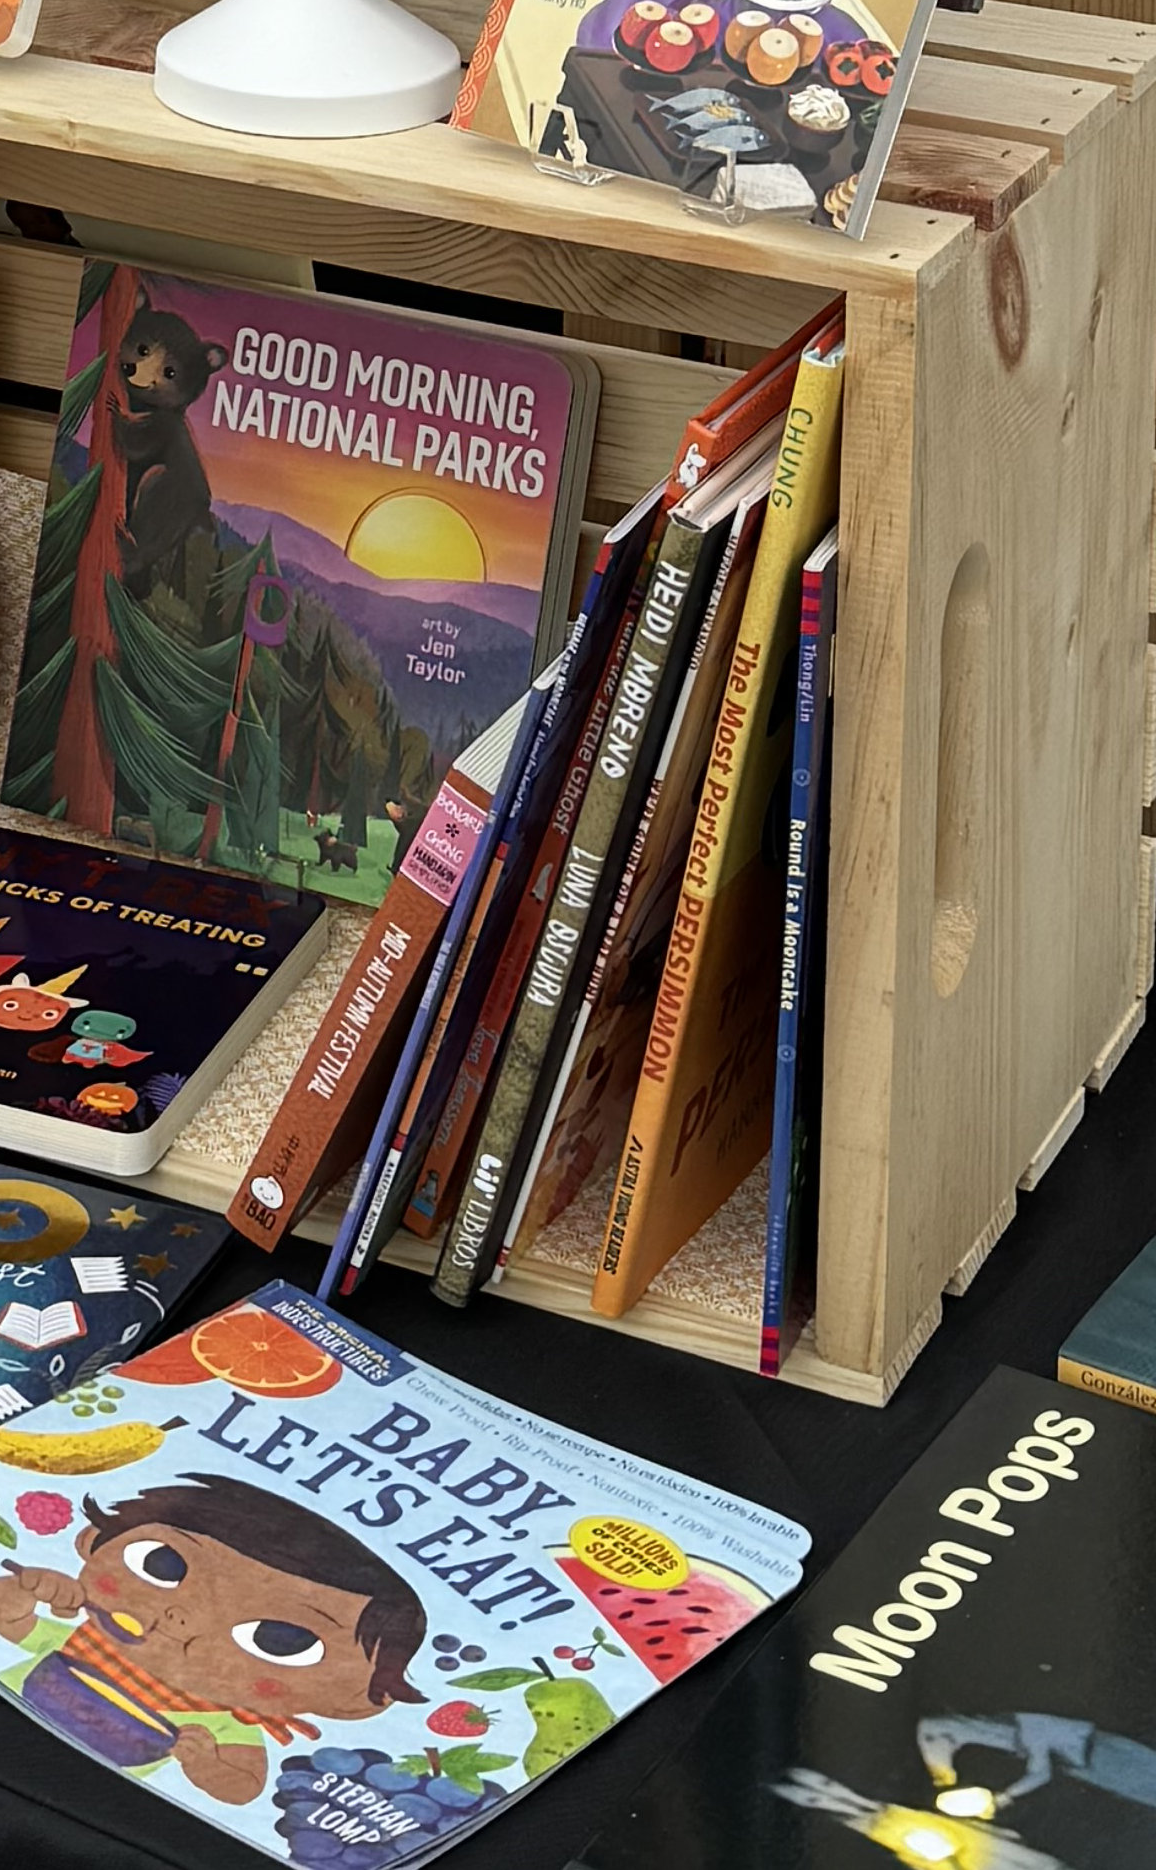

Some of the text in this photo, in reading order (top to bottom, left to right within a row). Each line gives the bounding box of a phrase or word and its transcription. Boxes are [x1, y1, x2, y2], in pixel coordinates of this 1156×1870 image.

[232, 327, 541, 442] GOOD MORNING,
[211, 380, 547, 499] NATIONAL PARKS
[771, 406, 813, 509] CHUNG
[422, 618, 462, 639] art by
[641, 560, 690, 645] HEIDI
[406, 654, 466, 685] Taylor
[420, 636, 455, 659] Jen
[726, 641, 760, 694] The
[799, 642, 818, 723] Thong/Lin
[600, 650, 659, 780] MORENO
[709, 697, 746, 775] Most
[69, 895, 114, 915] OF
[117, 905, 267, 949] TREATING
[527, 845, 605, 1008] LUNA OSCURA
[780, 817, 805, 1011] Round Is Mooncake
[643, 895, 705, 1084] PERSIMMON
[307, 1021, 362, 1100] FESTIVAL
[246, 1202, 276, 1231] BAO
[452, 1195, 495, 1271] LIBROS
[295, 1299, 326, 1320] THE
[197, 1391, 431, 1528] LET'S
[350, 1402, 576, 1554] BABY,
[407, 1376, 448, 1410] Chew
[449, 1400, 491, 1432] Proof
[587, 1473, 659, 1518] Nontoxic
[671, 1511, 716, 1542] 100%
[720, 1534, 796, 1579] Washable
[396, 1515, 575, 1631] EAT!
[584, 1541, 643, 1580] SOLD!
[591, 1527, 665, 1577] OF COPIES
[602, 1520, 679, 1572] MILLIONS
[809, 1409, 1095, 1692] Moon Pops
[307, 1803, 381, 1844] LOMP
[312, 1772, 421, 1836] STEPHAN
